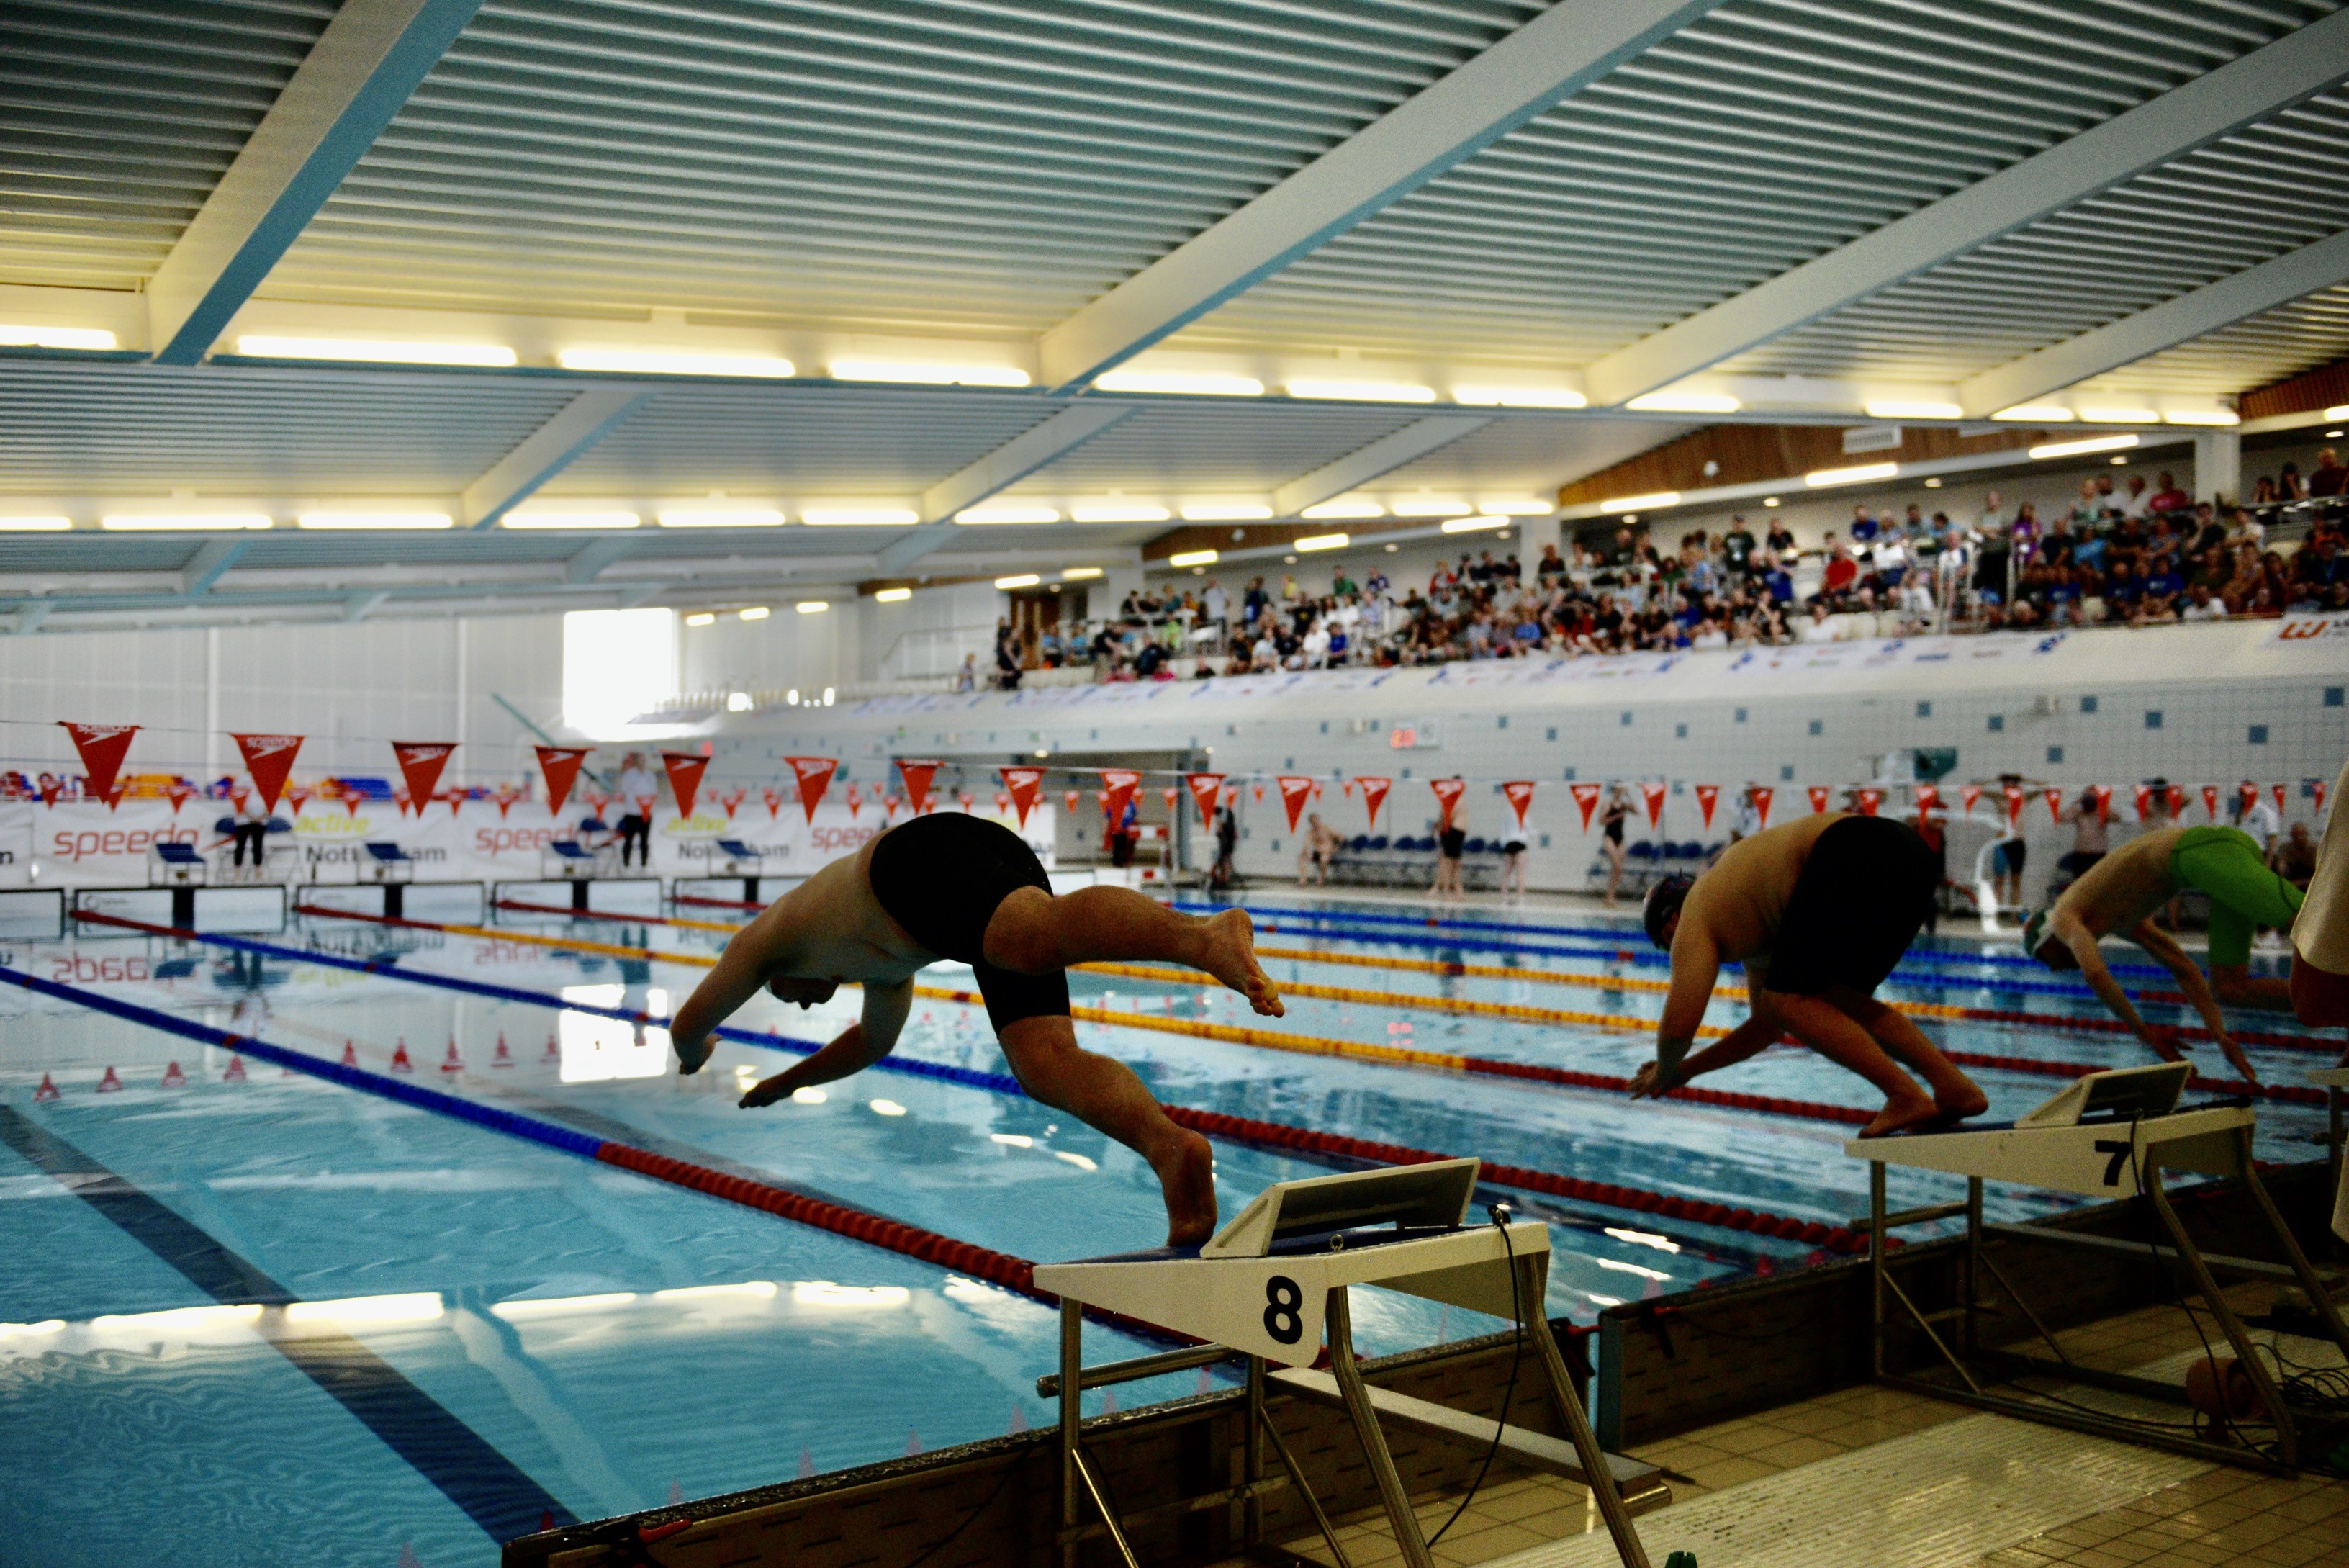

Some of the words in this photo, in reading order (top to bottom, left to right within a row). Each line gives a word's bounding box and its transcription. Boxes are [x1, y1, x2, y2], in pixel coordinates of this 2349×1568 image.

[247, 736, 297, 748] speedo
[294, 812, 369, 834] active
[811, 826, 875, 854] spee
[2094, 1140, 2132, 1186] 7
[1263, 1275, 1303, 1345] 8
